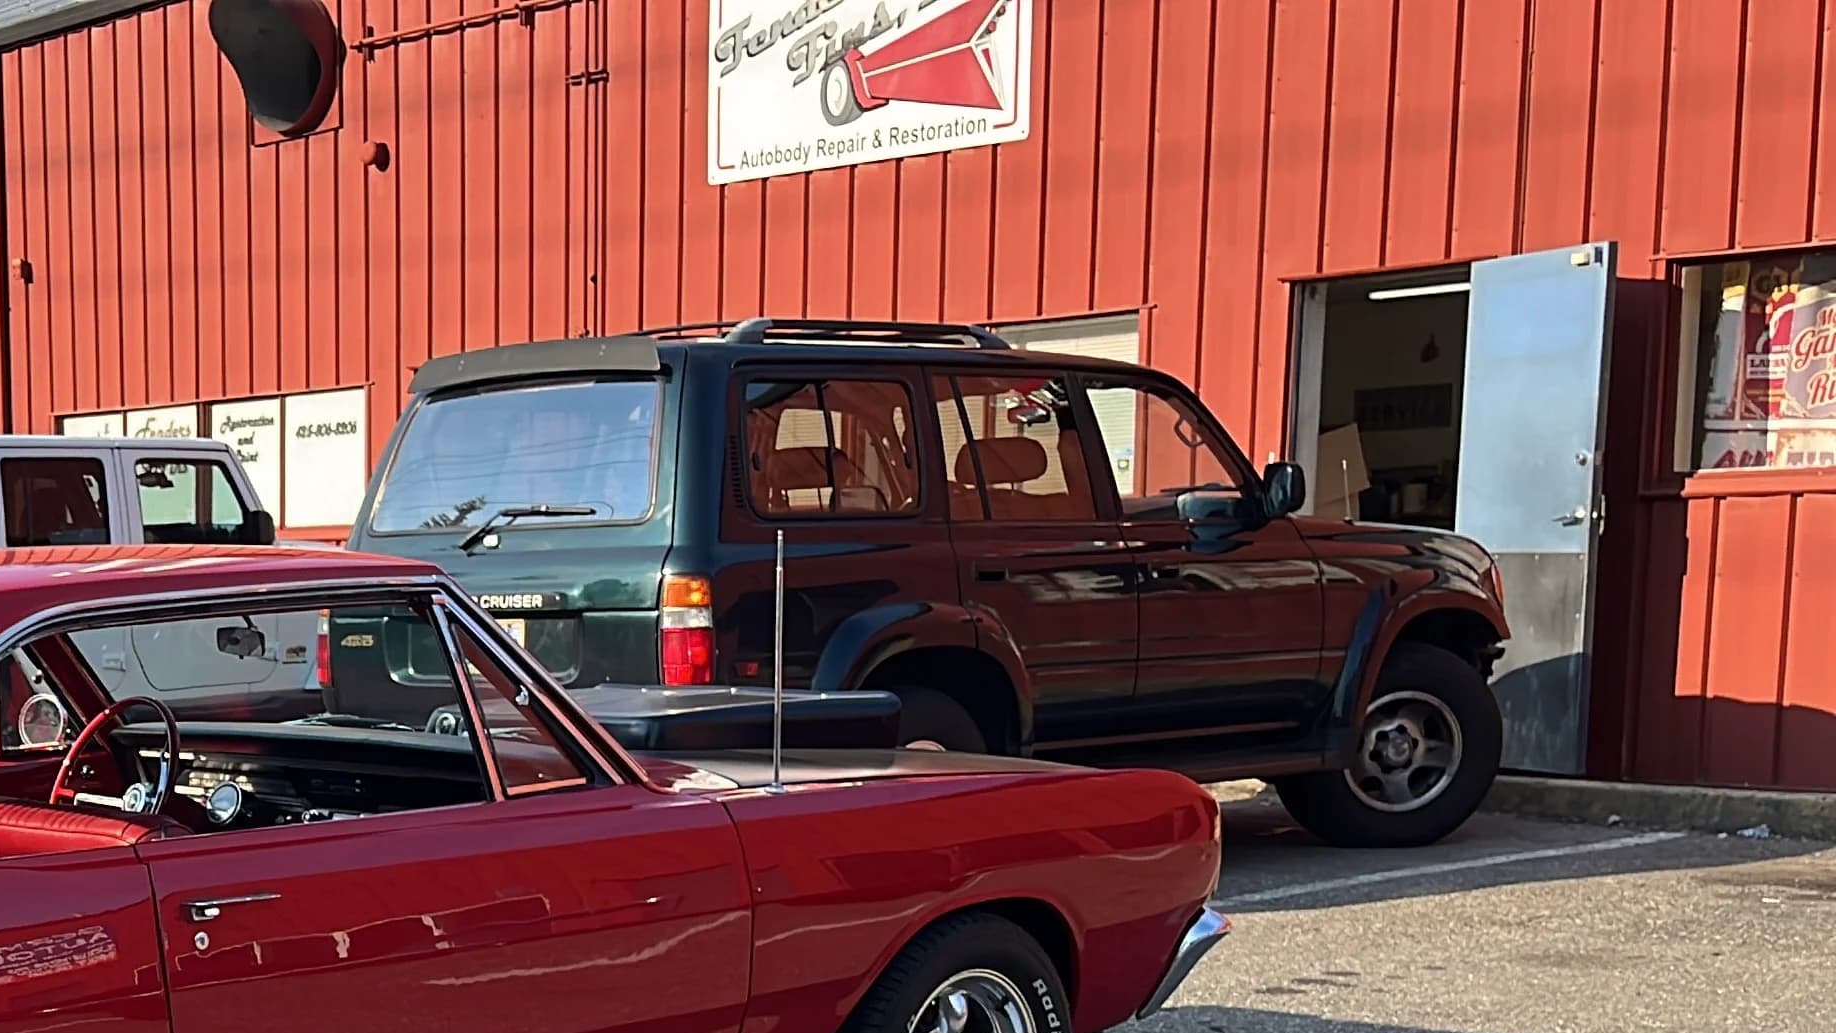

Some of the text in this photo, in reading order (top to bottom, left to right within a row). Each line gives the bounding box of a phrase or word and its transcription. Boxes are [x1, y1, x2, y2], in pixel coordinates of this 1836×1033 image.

[740, 117, 988, 170] Autobody Repair & Restoration
[135, 417, 192, 437] Fenders
[237, 431, 255, 446] and
[480, 594, 543, 608] CRUISER
